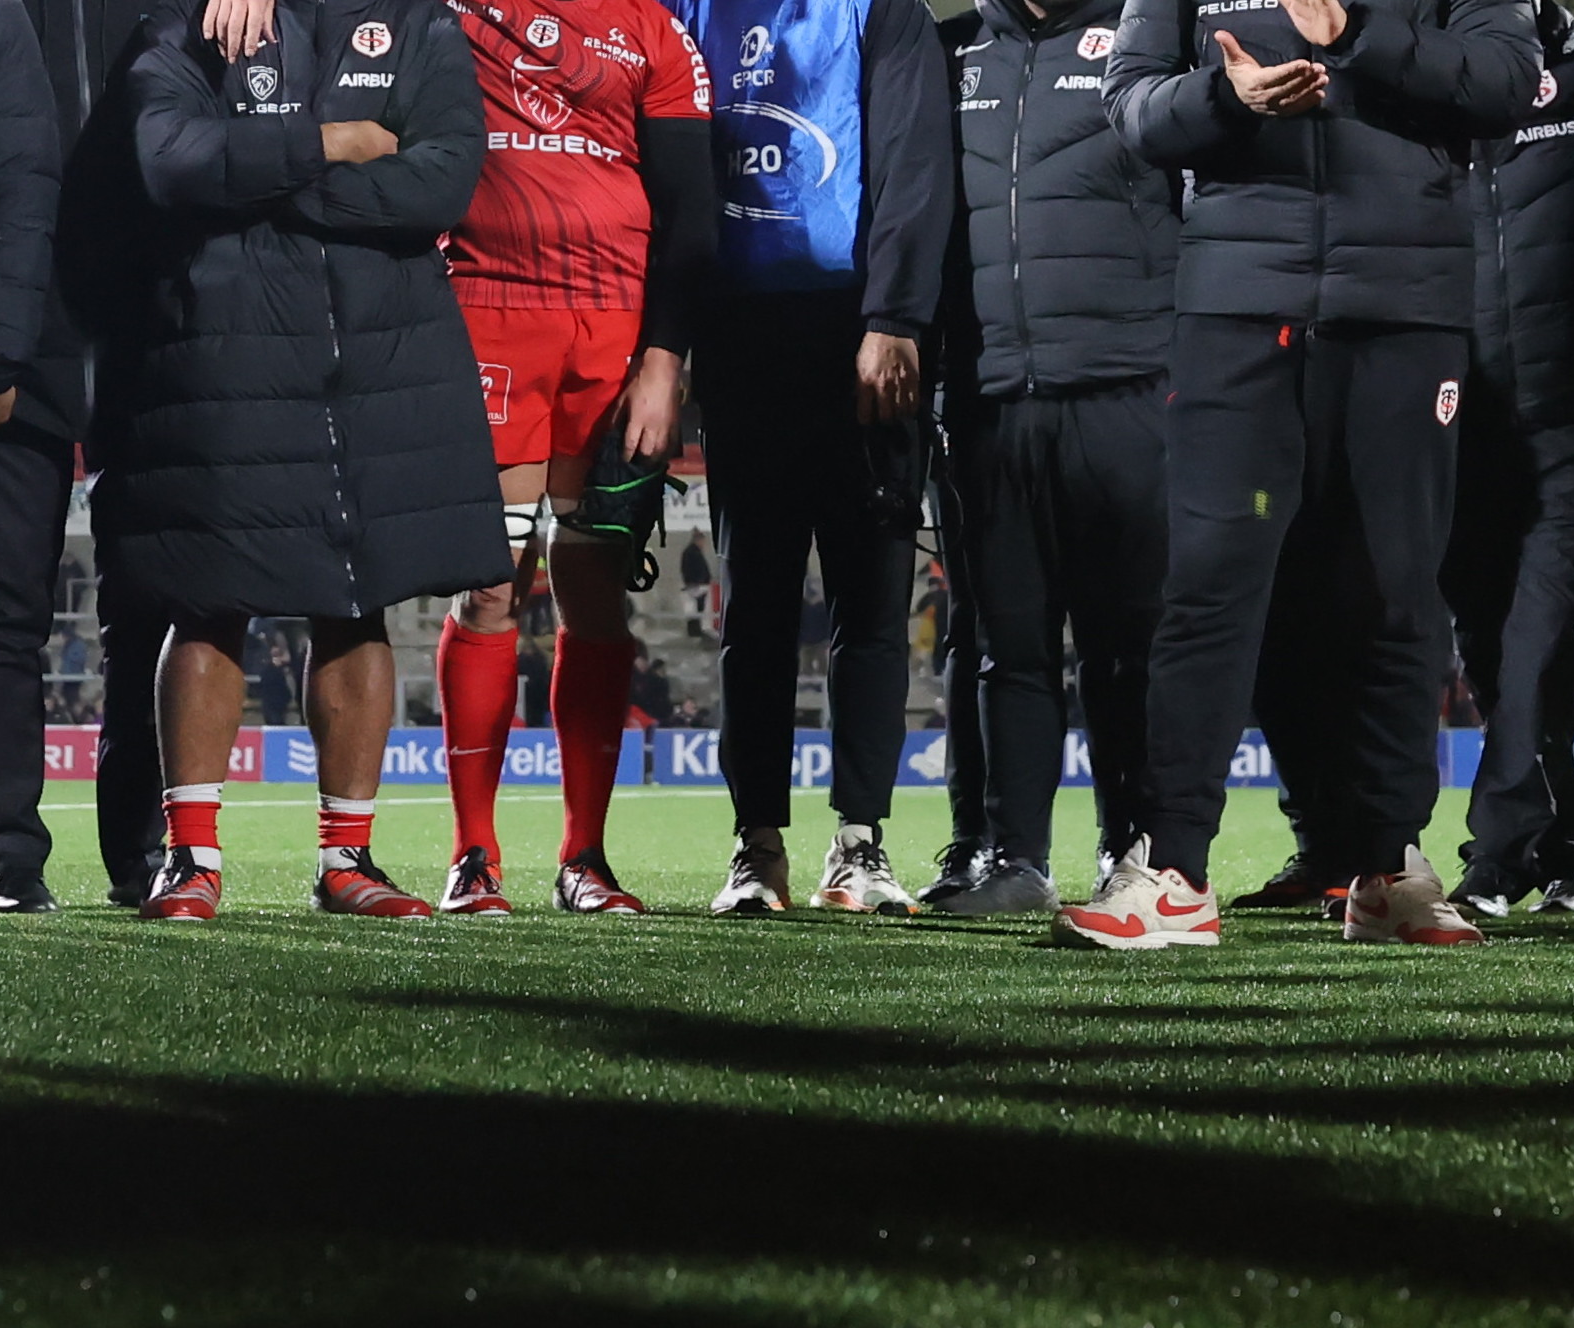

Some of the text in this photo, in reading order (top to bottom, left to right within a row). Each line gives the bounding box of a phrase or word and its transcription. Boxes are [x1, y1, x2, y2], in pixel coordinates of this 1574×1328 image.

[338, 73, 395, 88] AIRBU
[732, 69, 775, 90] EPCR
[488, 131, 622, 162] EUGEOT
